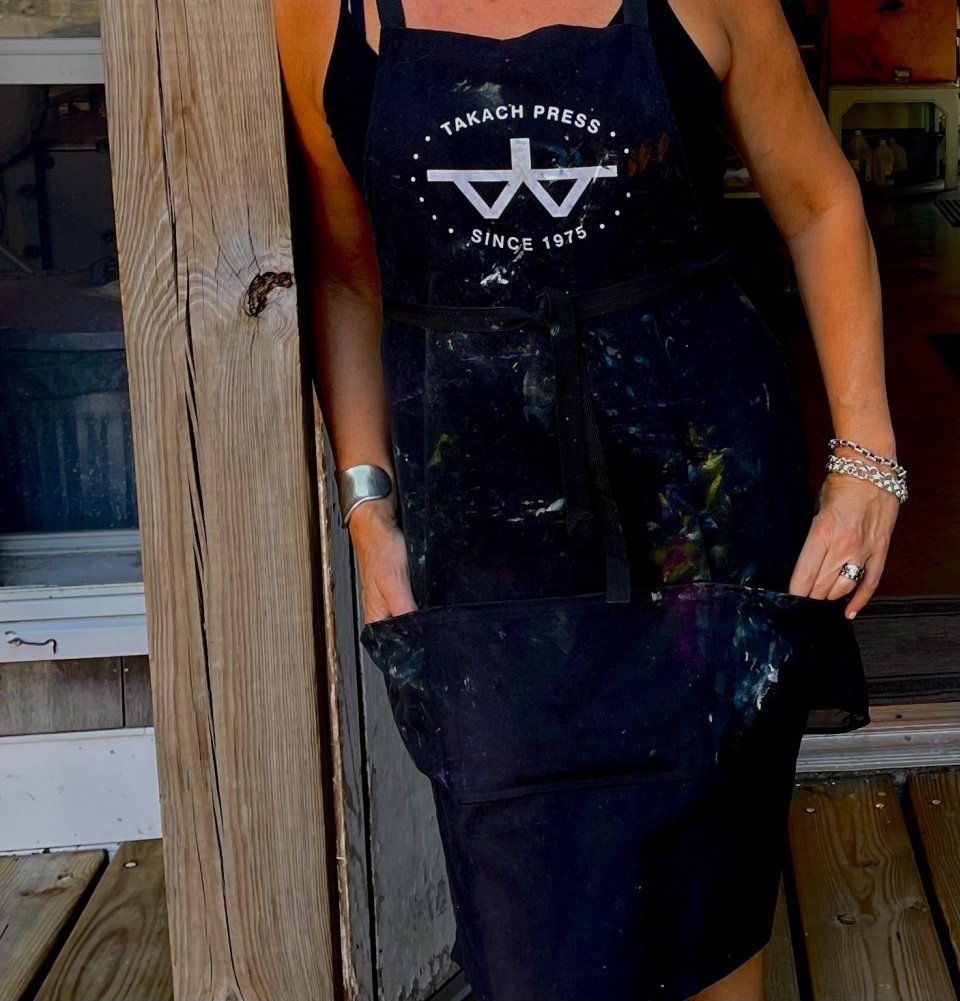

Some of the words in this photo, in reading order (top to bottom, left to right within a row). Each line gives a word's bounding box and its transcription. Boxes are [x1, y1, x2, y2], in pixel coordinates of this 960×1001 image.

[440, 104, 524, 136] TAKACH
[533, 105, 601, 134] PRESS
[470, 229, 533, 251] SINCE
[542, 225, 587, 249] 1975
